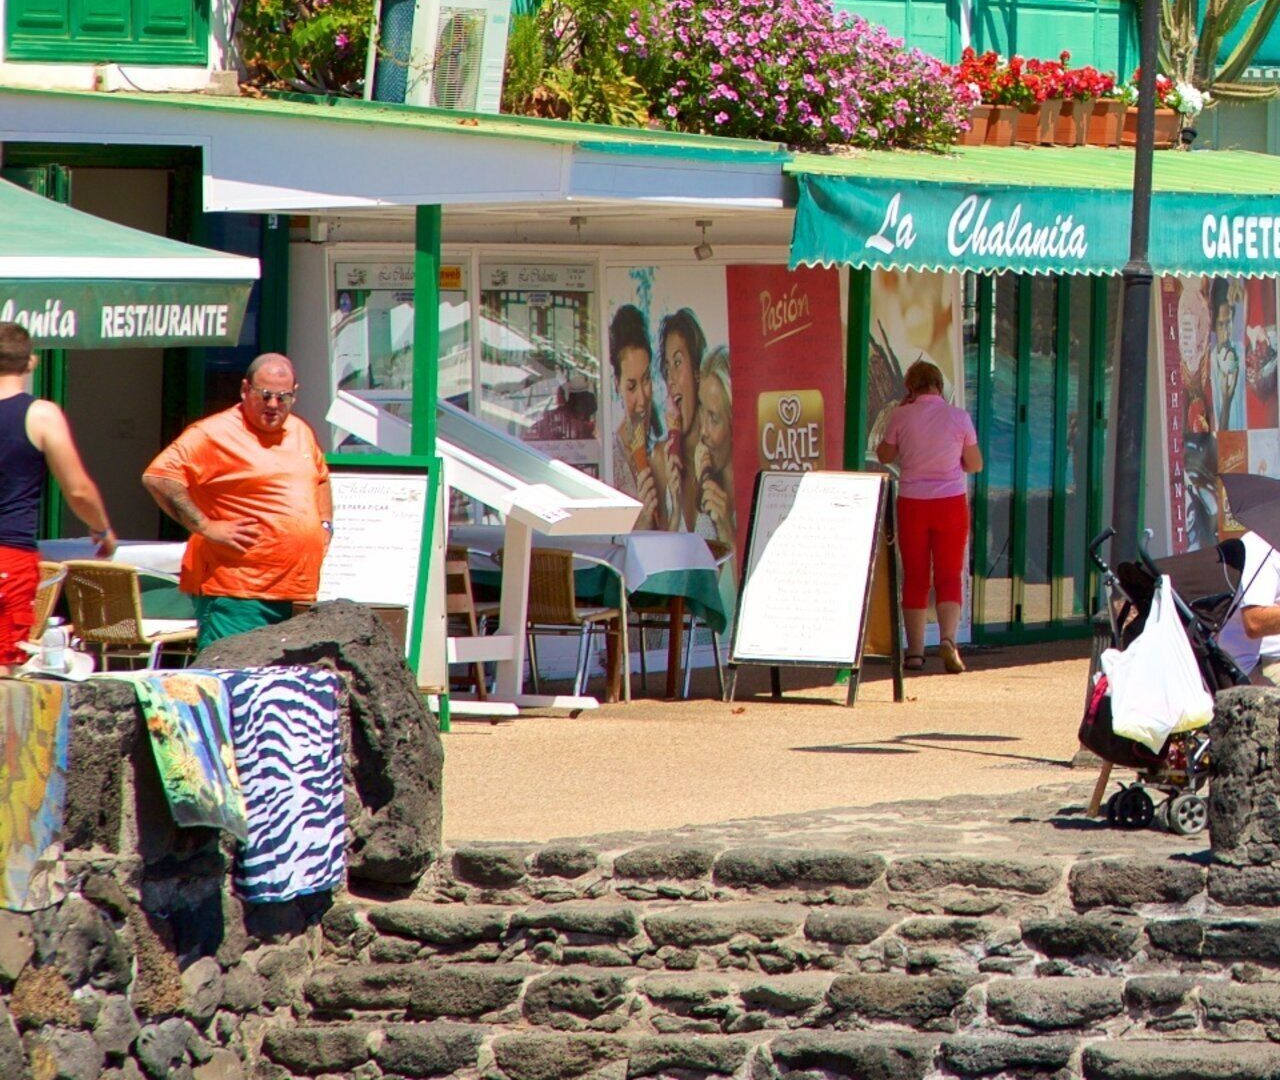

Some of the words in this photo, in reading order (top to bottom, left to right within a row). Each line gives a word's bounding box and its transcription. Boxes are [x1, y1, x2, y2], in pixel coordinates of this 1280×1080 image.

[864, 192, 917, 255] La
[947, 194, 1089, 259] Chalanita
[101, 304, 228, 338] RESTAURANTE
[760, 283, 810, 336] Pasión
[762, 422, 820, 463] CARTE
[1170, 370, 1184, 543] CHALANIT
